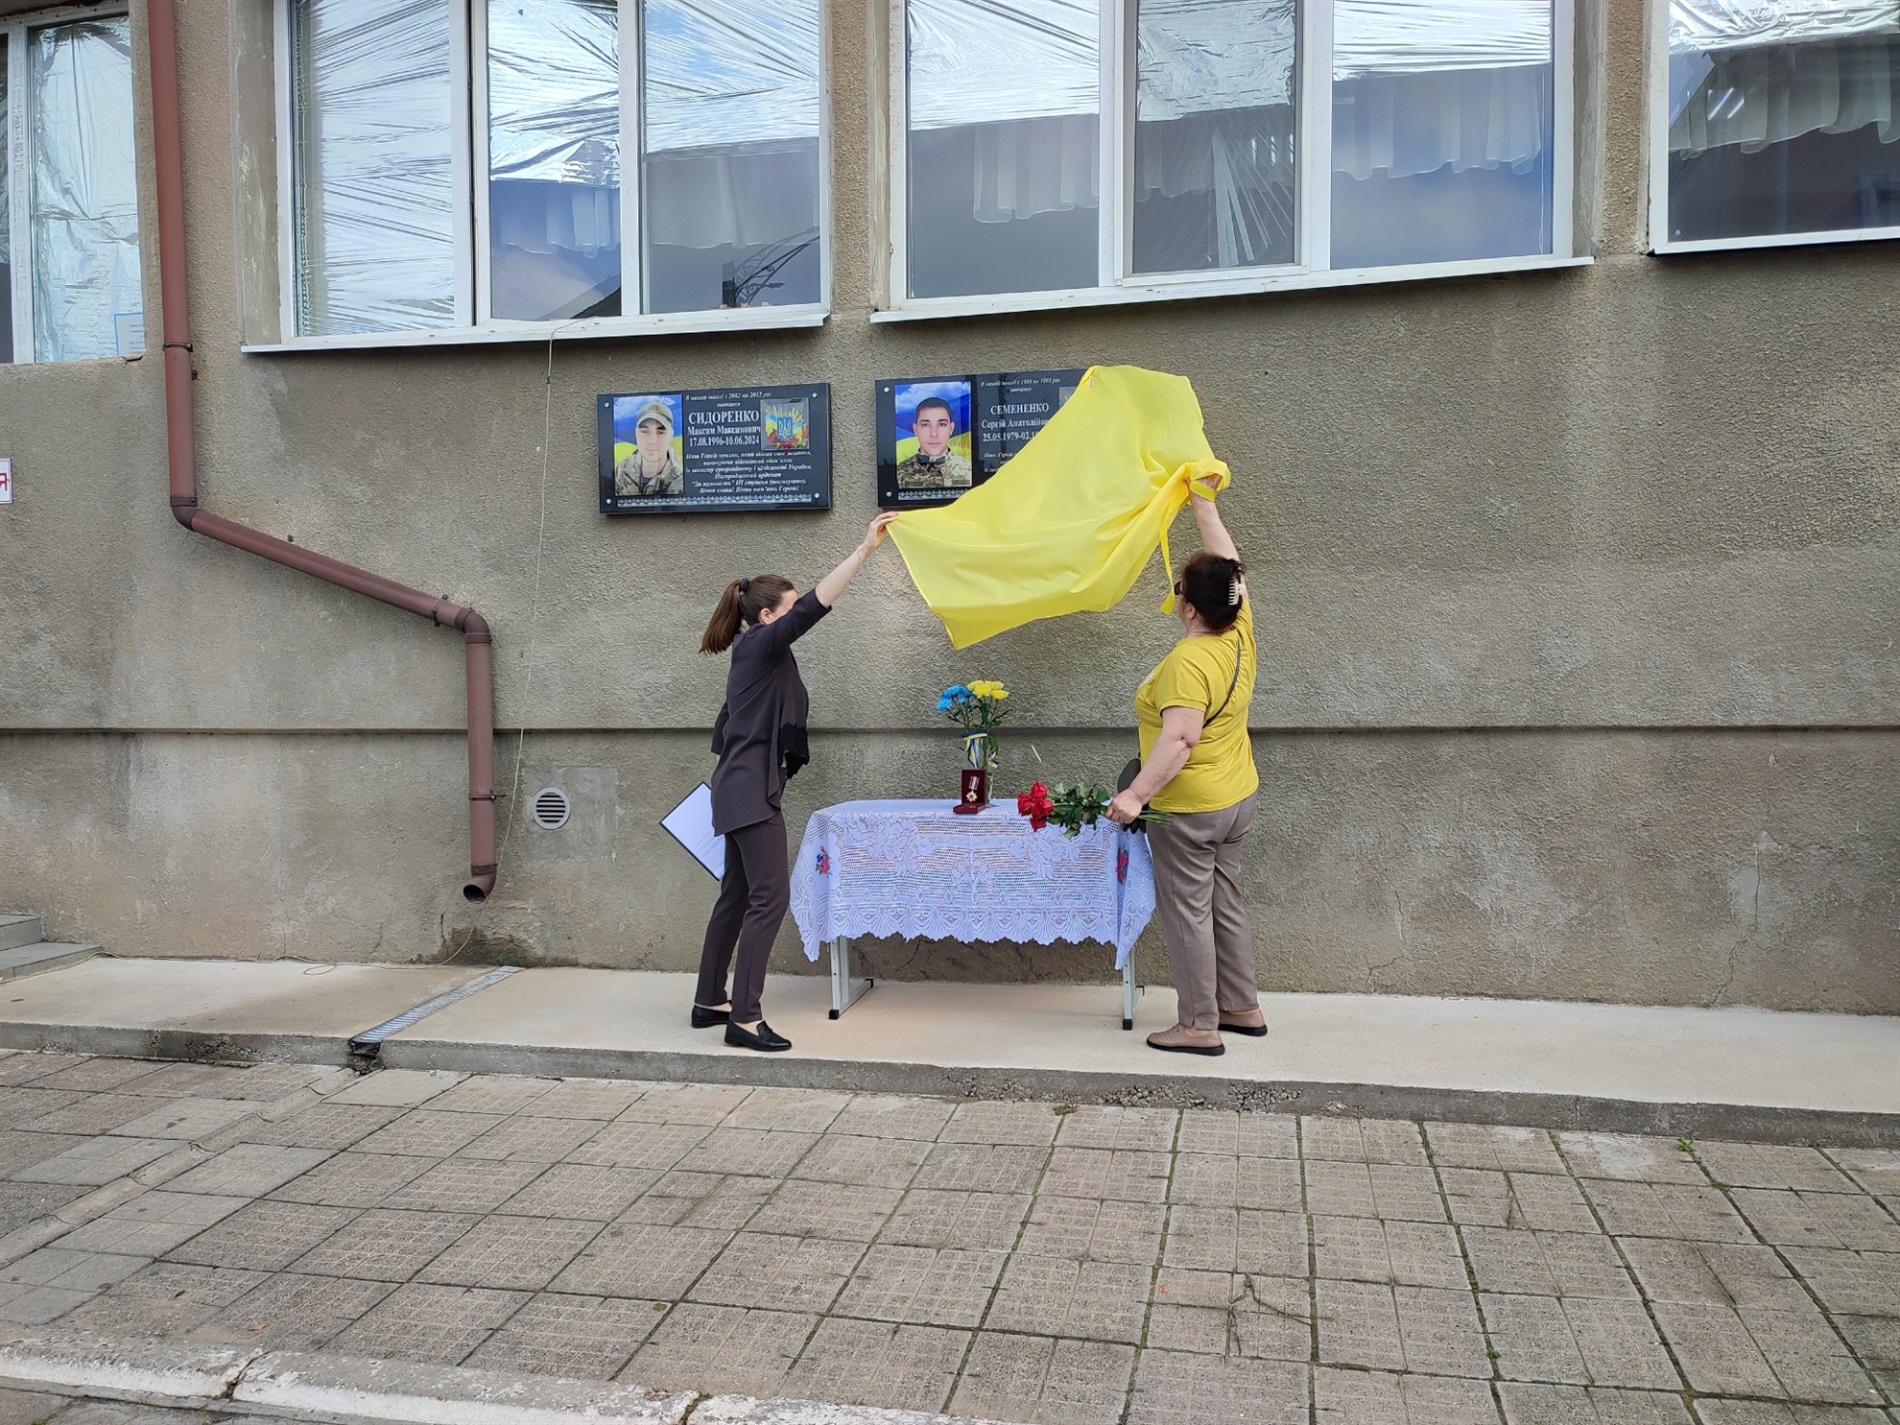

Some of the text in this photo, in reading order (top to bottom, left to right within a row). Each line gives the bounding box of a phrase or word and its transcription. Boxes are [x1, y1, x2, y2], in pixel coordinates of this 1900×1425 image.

[990, 403, 1049, 415] СЕМЕНЕНКО
[688, 410, 759, 425] СИДОРЕНКО
[981, 419, 1006, 430] Сергій
[688, 425, 761, 436] Максим Максимович
